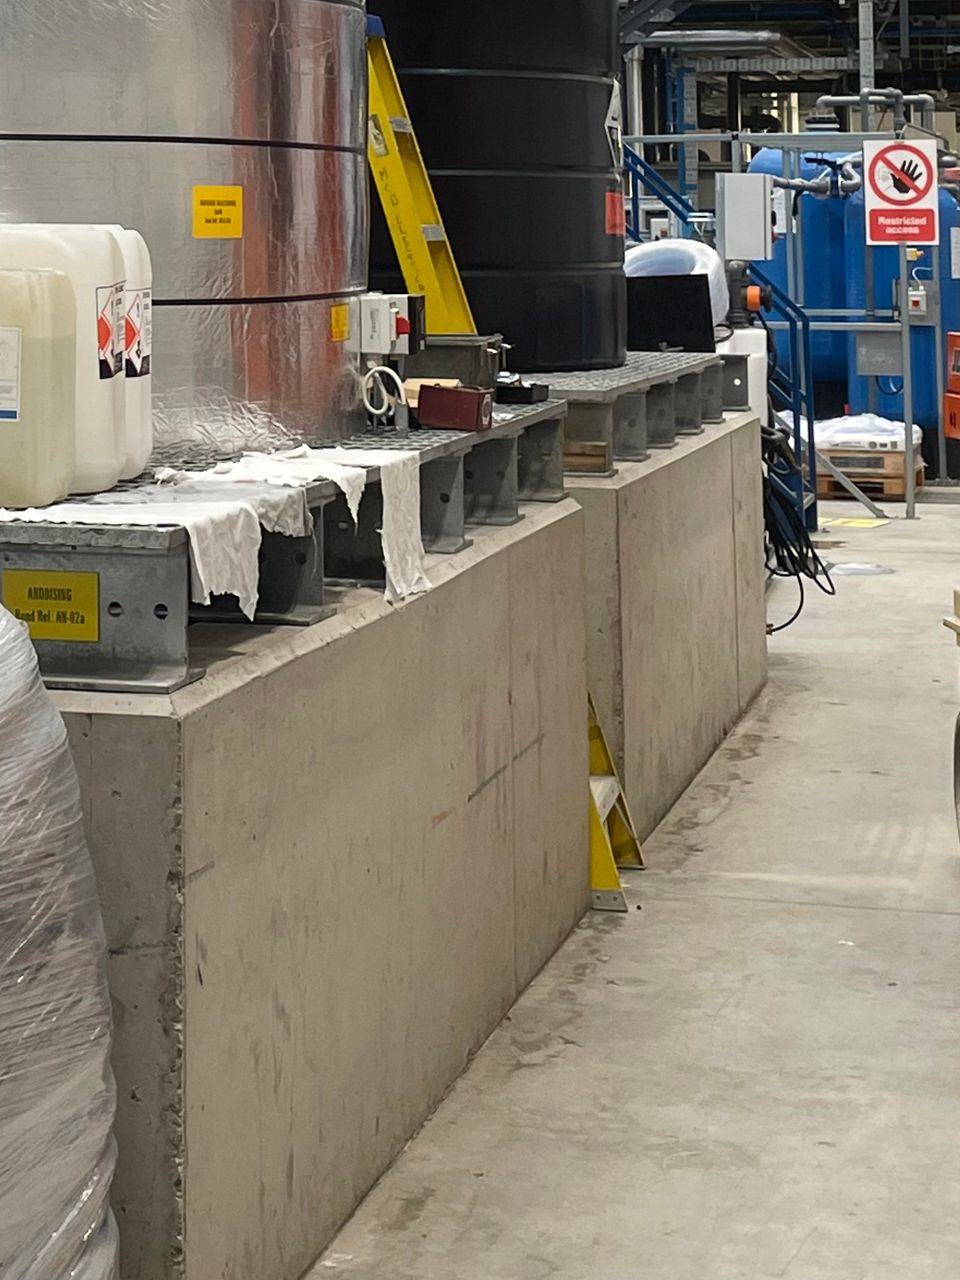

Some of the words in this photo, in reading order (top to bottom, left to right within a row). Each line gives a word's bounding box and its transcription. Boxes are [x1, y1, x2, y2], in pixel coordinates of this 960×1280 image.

[878, 216, 927, 225] Restricted
[885, 226, 920, 234] access
[28, 587, 72, 601] ANODISING
